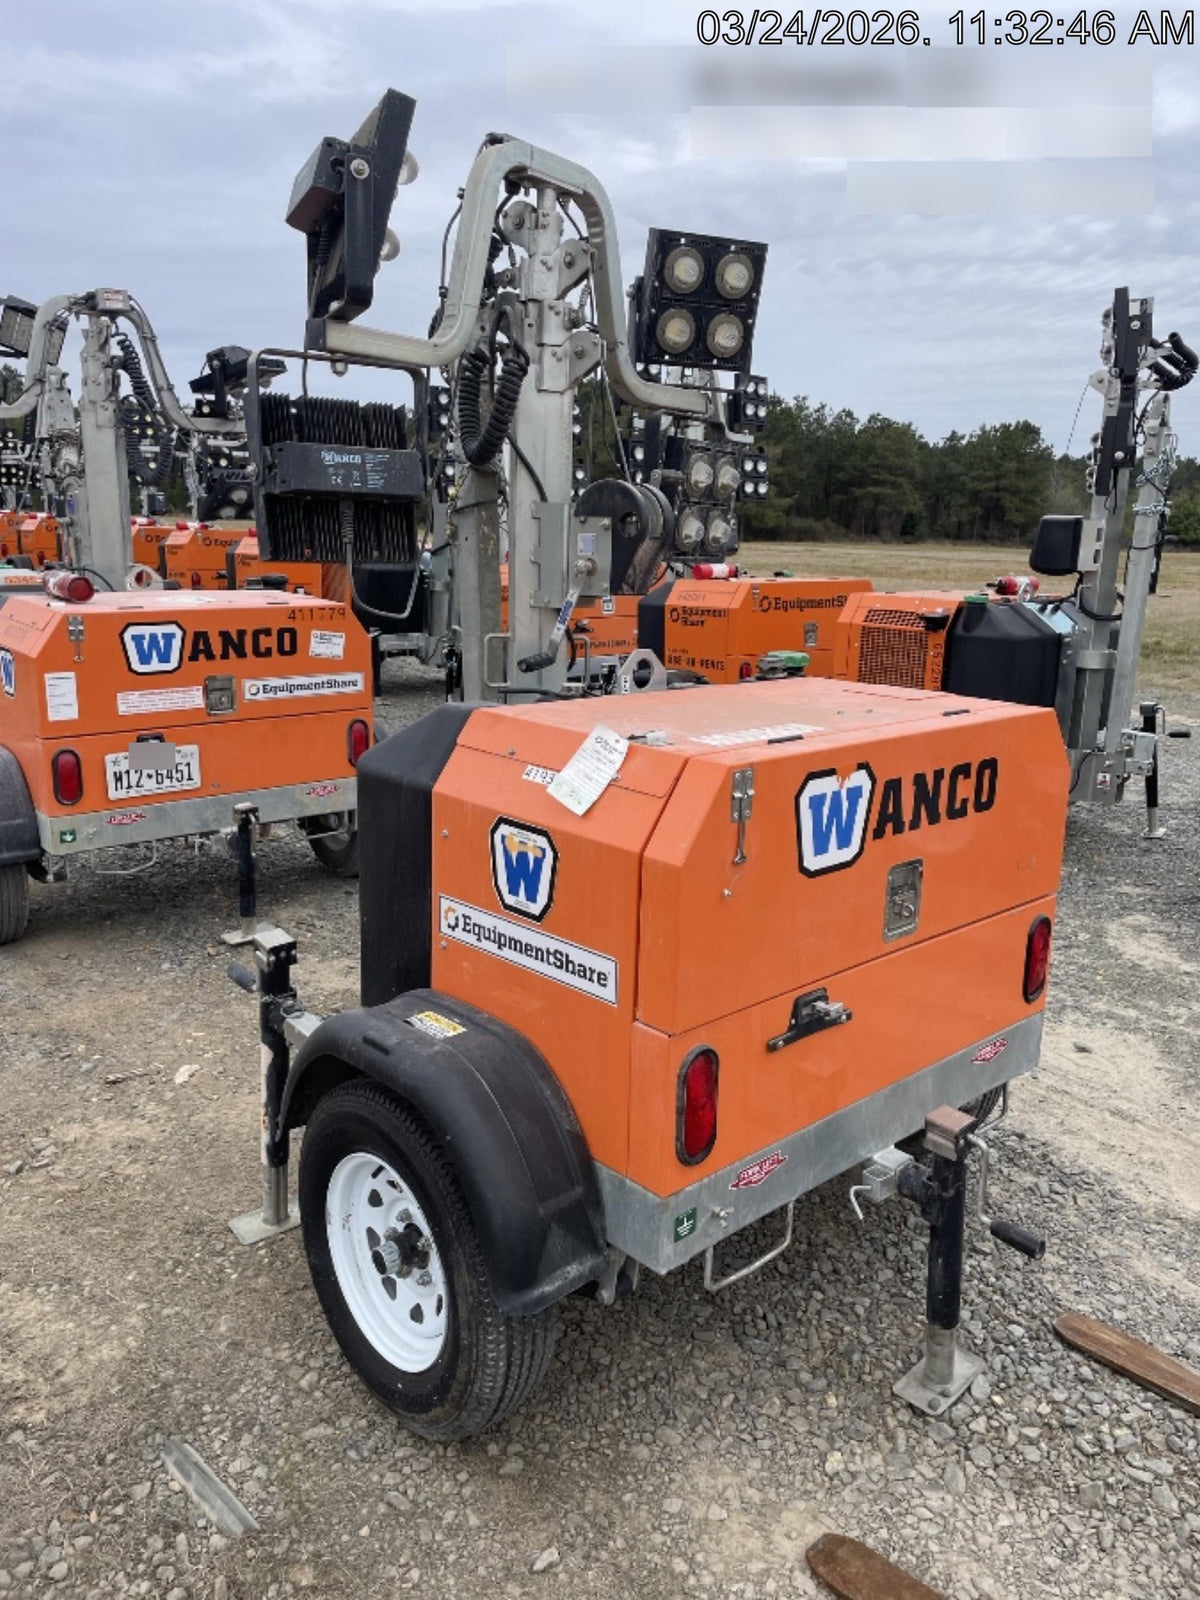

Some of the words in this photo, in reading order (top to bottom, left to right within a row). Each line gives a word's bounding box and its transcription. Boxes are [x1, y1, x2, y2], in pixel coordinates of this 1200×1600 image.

[131, 627, 298, 666] WANCO
[262, 677, 358, 696] EquipmentShare
[808, 757, 998, 857] WANCO
[501, 833, 546, 905] W
[462, 914, 608, 988] EquipmentShare
